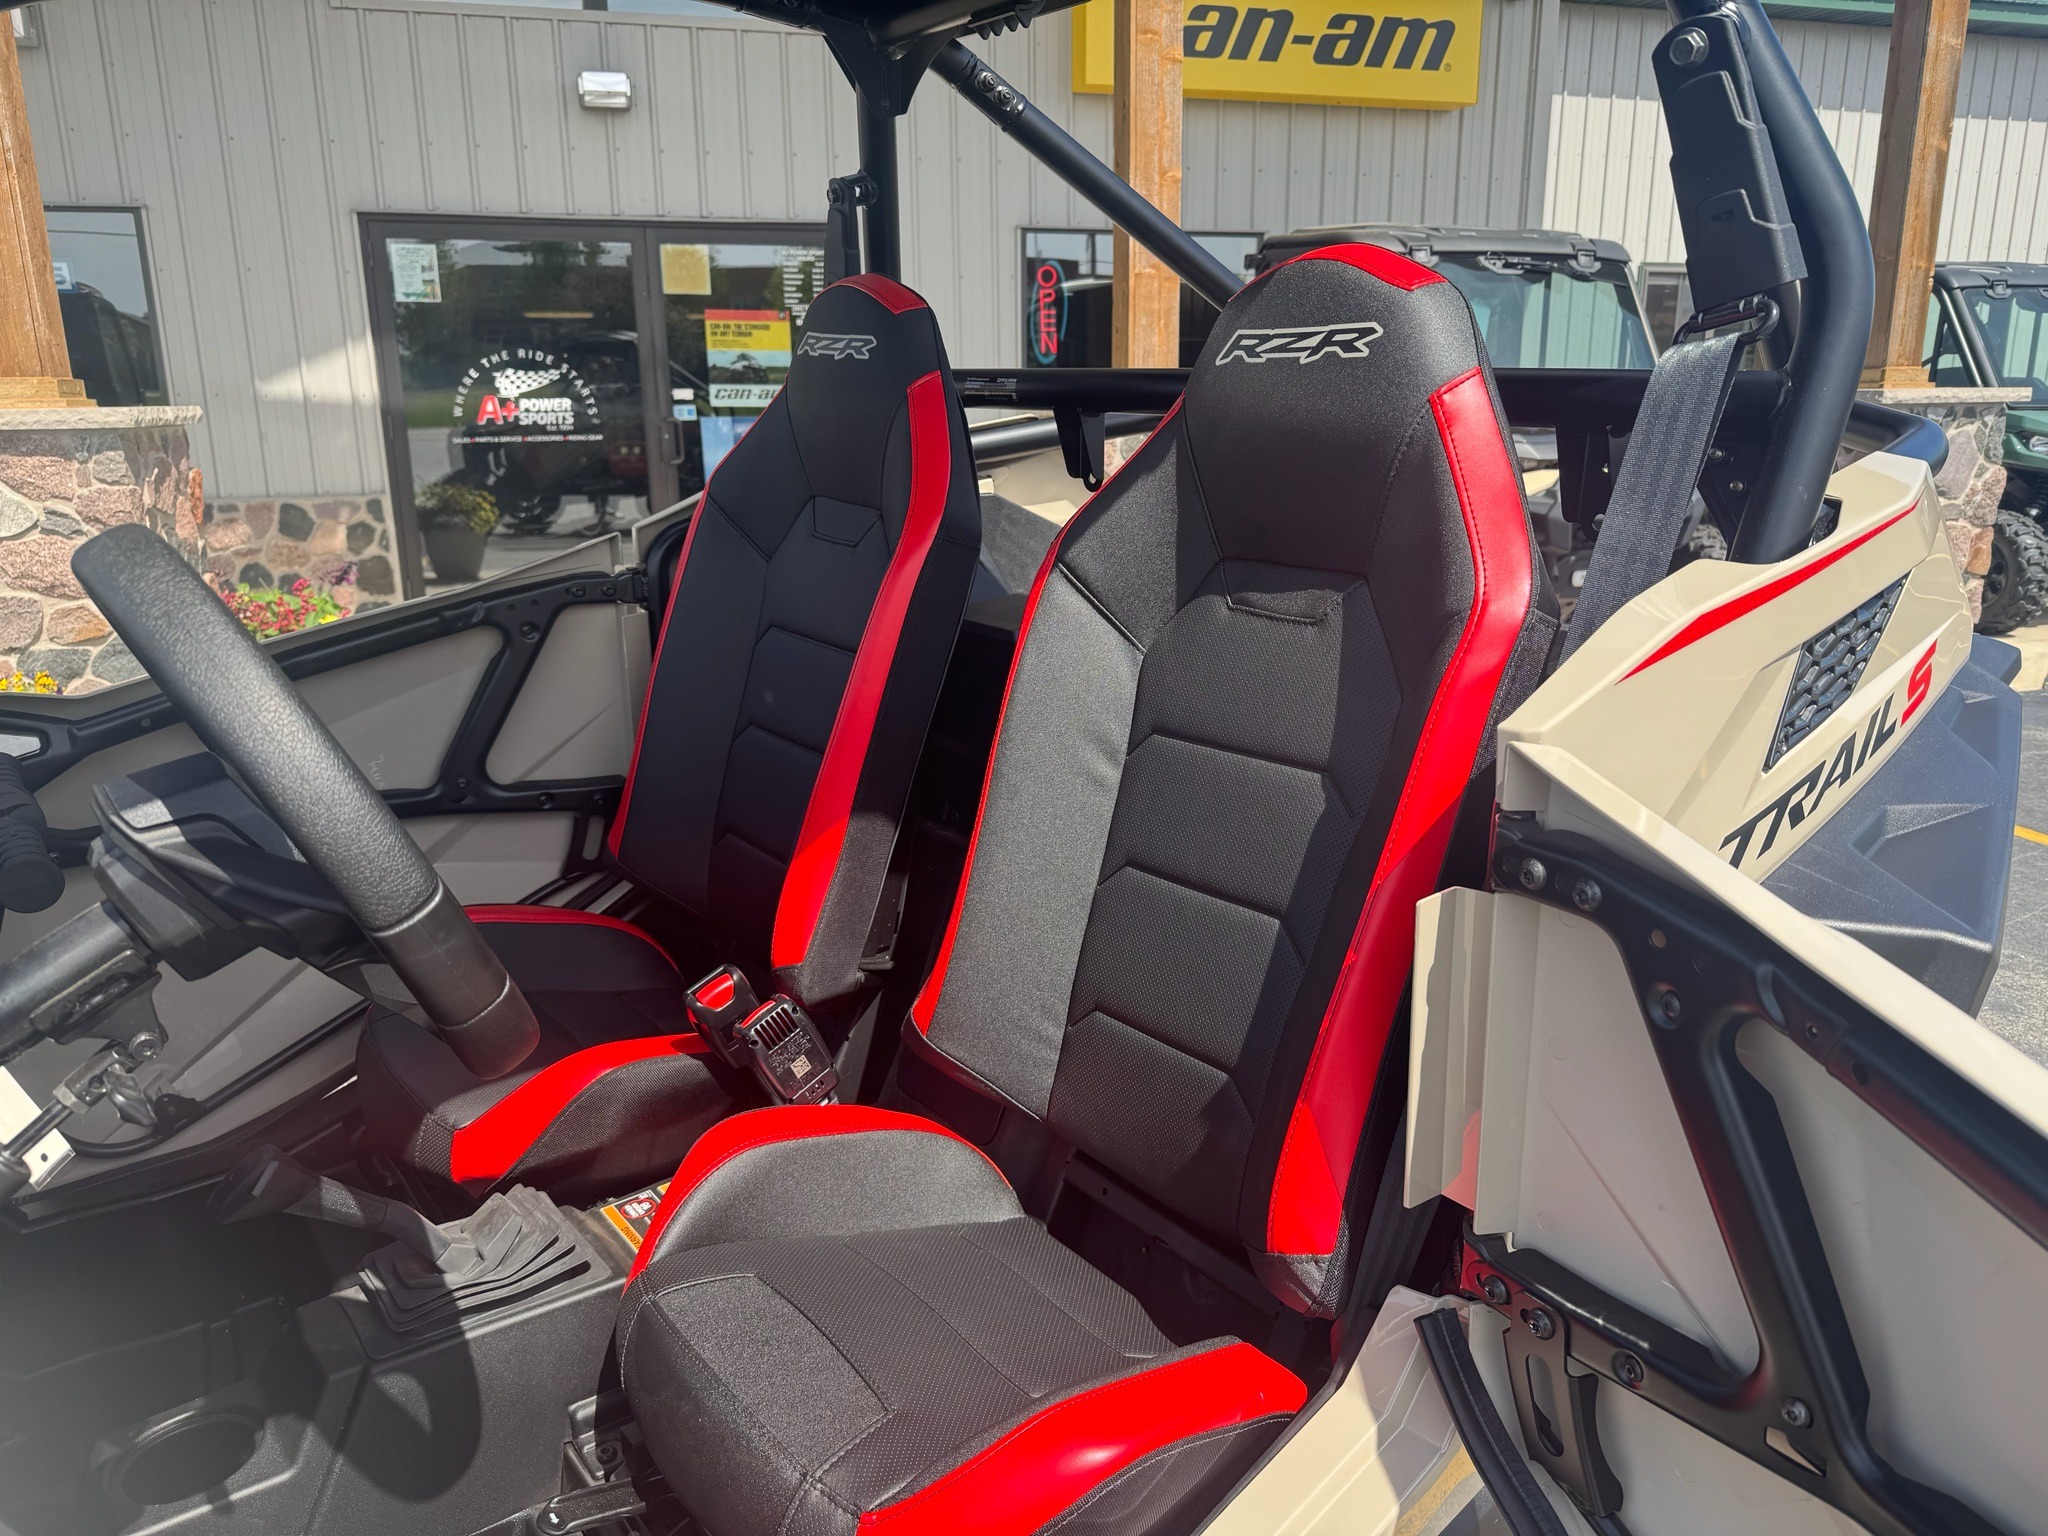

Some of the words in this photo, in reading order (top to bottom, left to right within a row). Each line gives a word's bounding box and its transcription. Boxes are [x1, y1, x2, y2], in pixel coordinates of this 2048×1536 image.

[1183, 4, 1456, 71] an-am
[1037, 265, 1058, 354] OPEN
[797, 331, 877, 360] RZR
[1215, 321, 1384, 366] RZR
[452, 367, 480, 417] WHERE
[480, 350, 510, 368] THE
[517, 347, 555, 366] RIDE
[560, 362, 598, 416] STARTS
[518, 397, 573, 412] POWER
[715, 387, 778, 400] can-a
[517, 411, 575, 426] SPORTS
[1718, 691, 1898, 870] TRAIL
[1899, 638, 1938, 728] S
